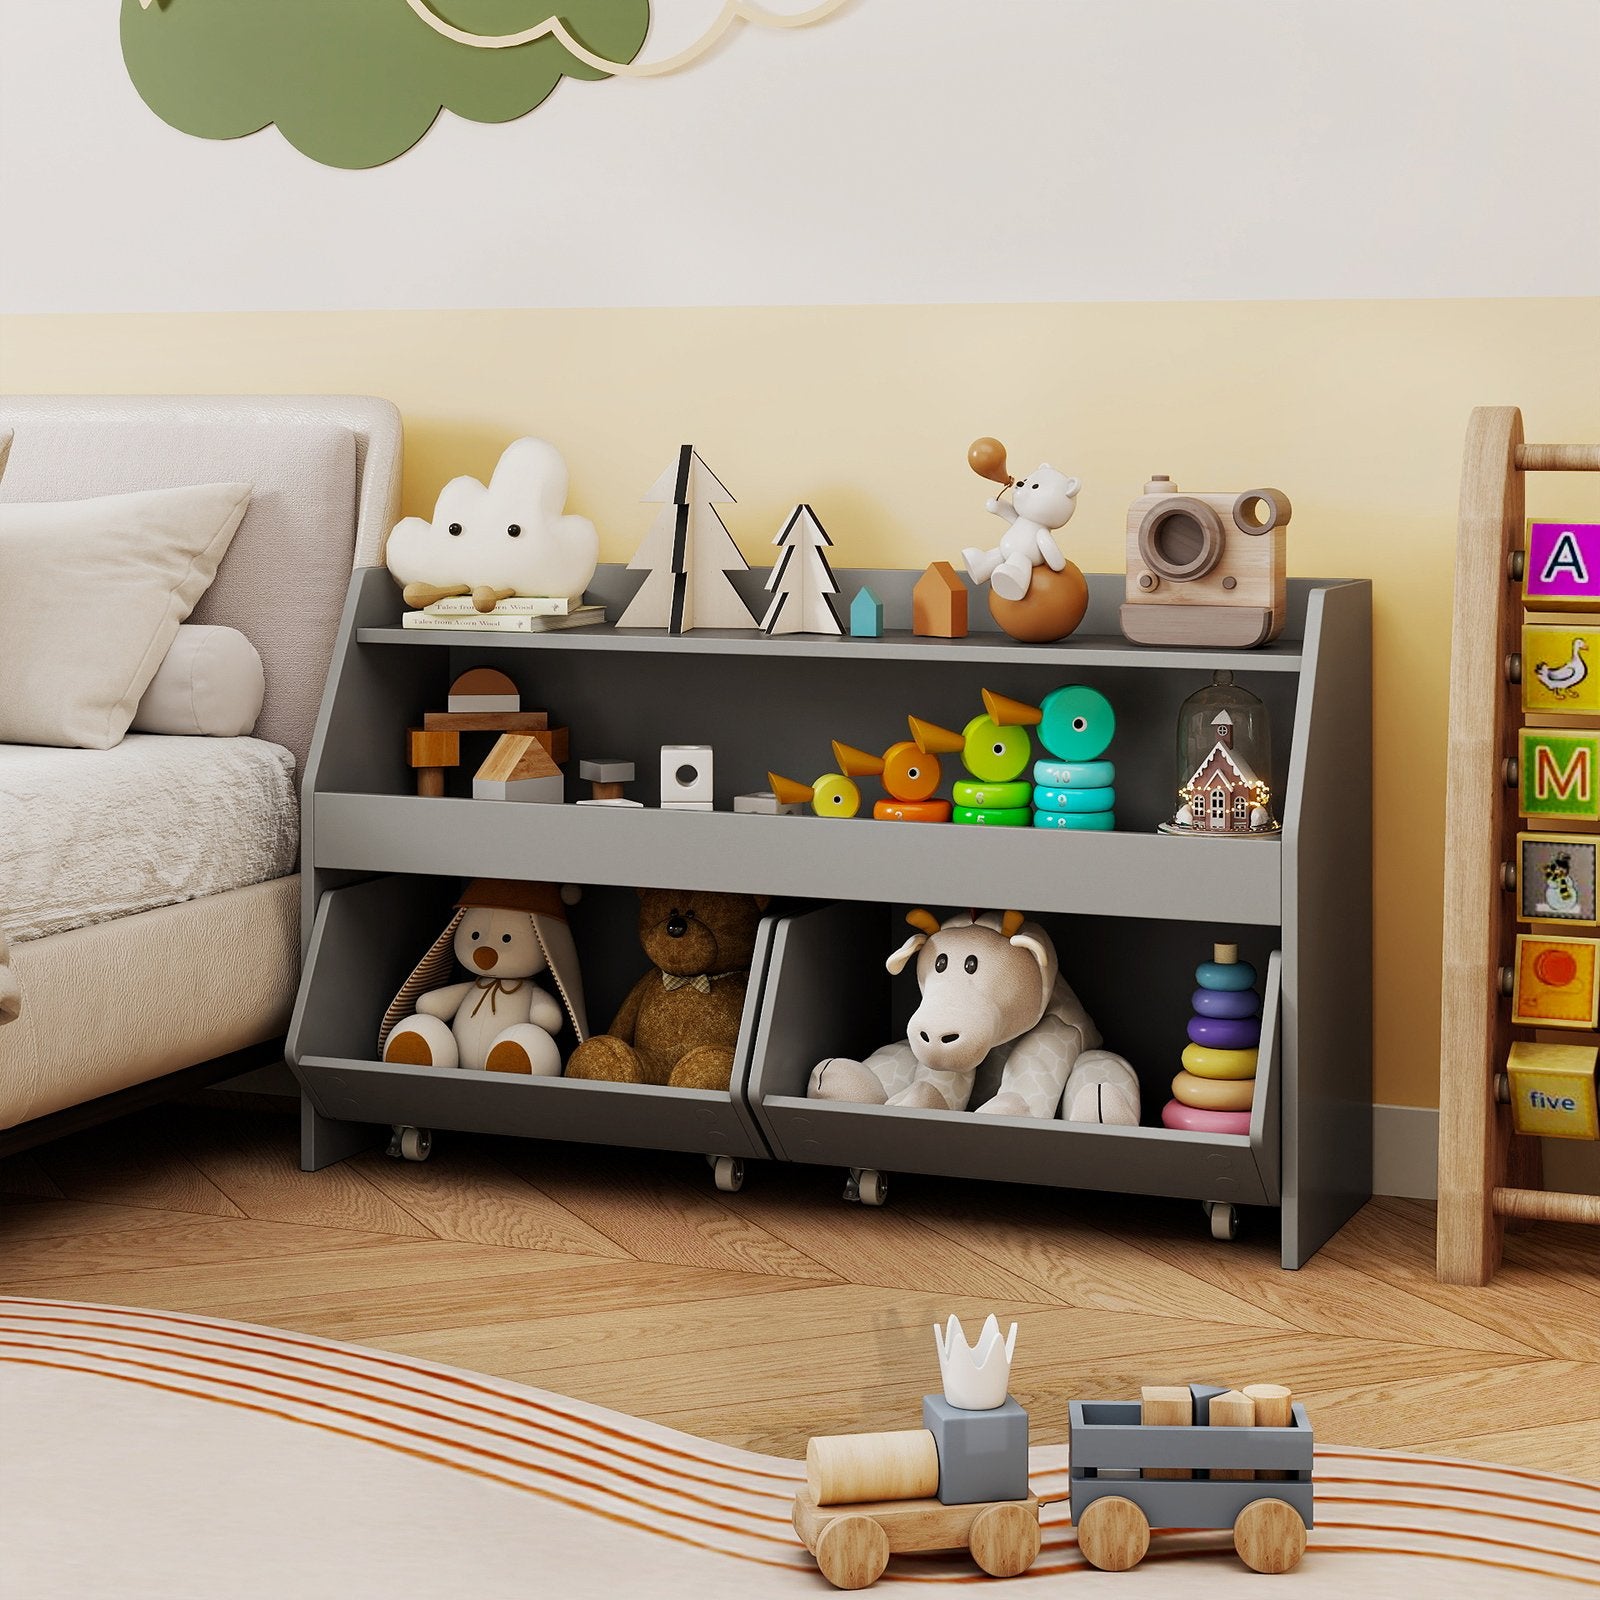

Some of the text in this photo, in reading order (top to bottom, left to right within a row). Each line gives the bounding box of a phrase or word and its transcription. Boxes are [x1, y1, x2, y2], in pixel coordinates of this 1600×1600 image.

[1541, 532, 1588, 582] A
[1053, 770, 1071, 783] 10
[1535, 746, 1590, 800] M
[975, 792, 984, 804] 6
[1057, 794, 1067, 807] 9
[976, 814, 985, 825] 5
[1530, 1091, 1576, 1111] five
